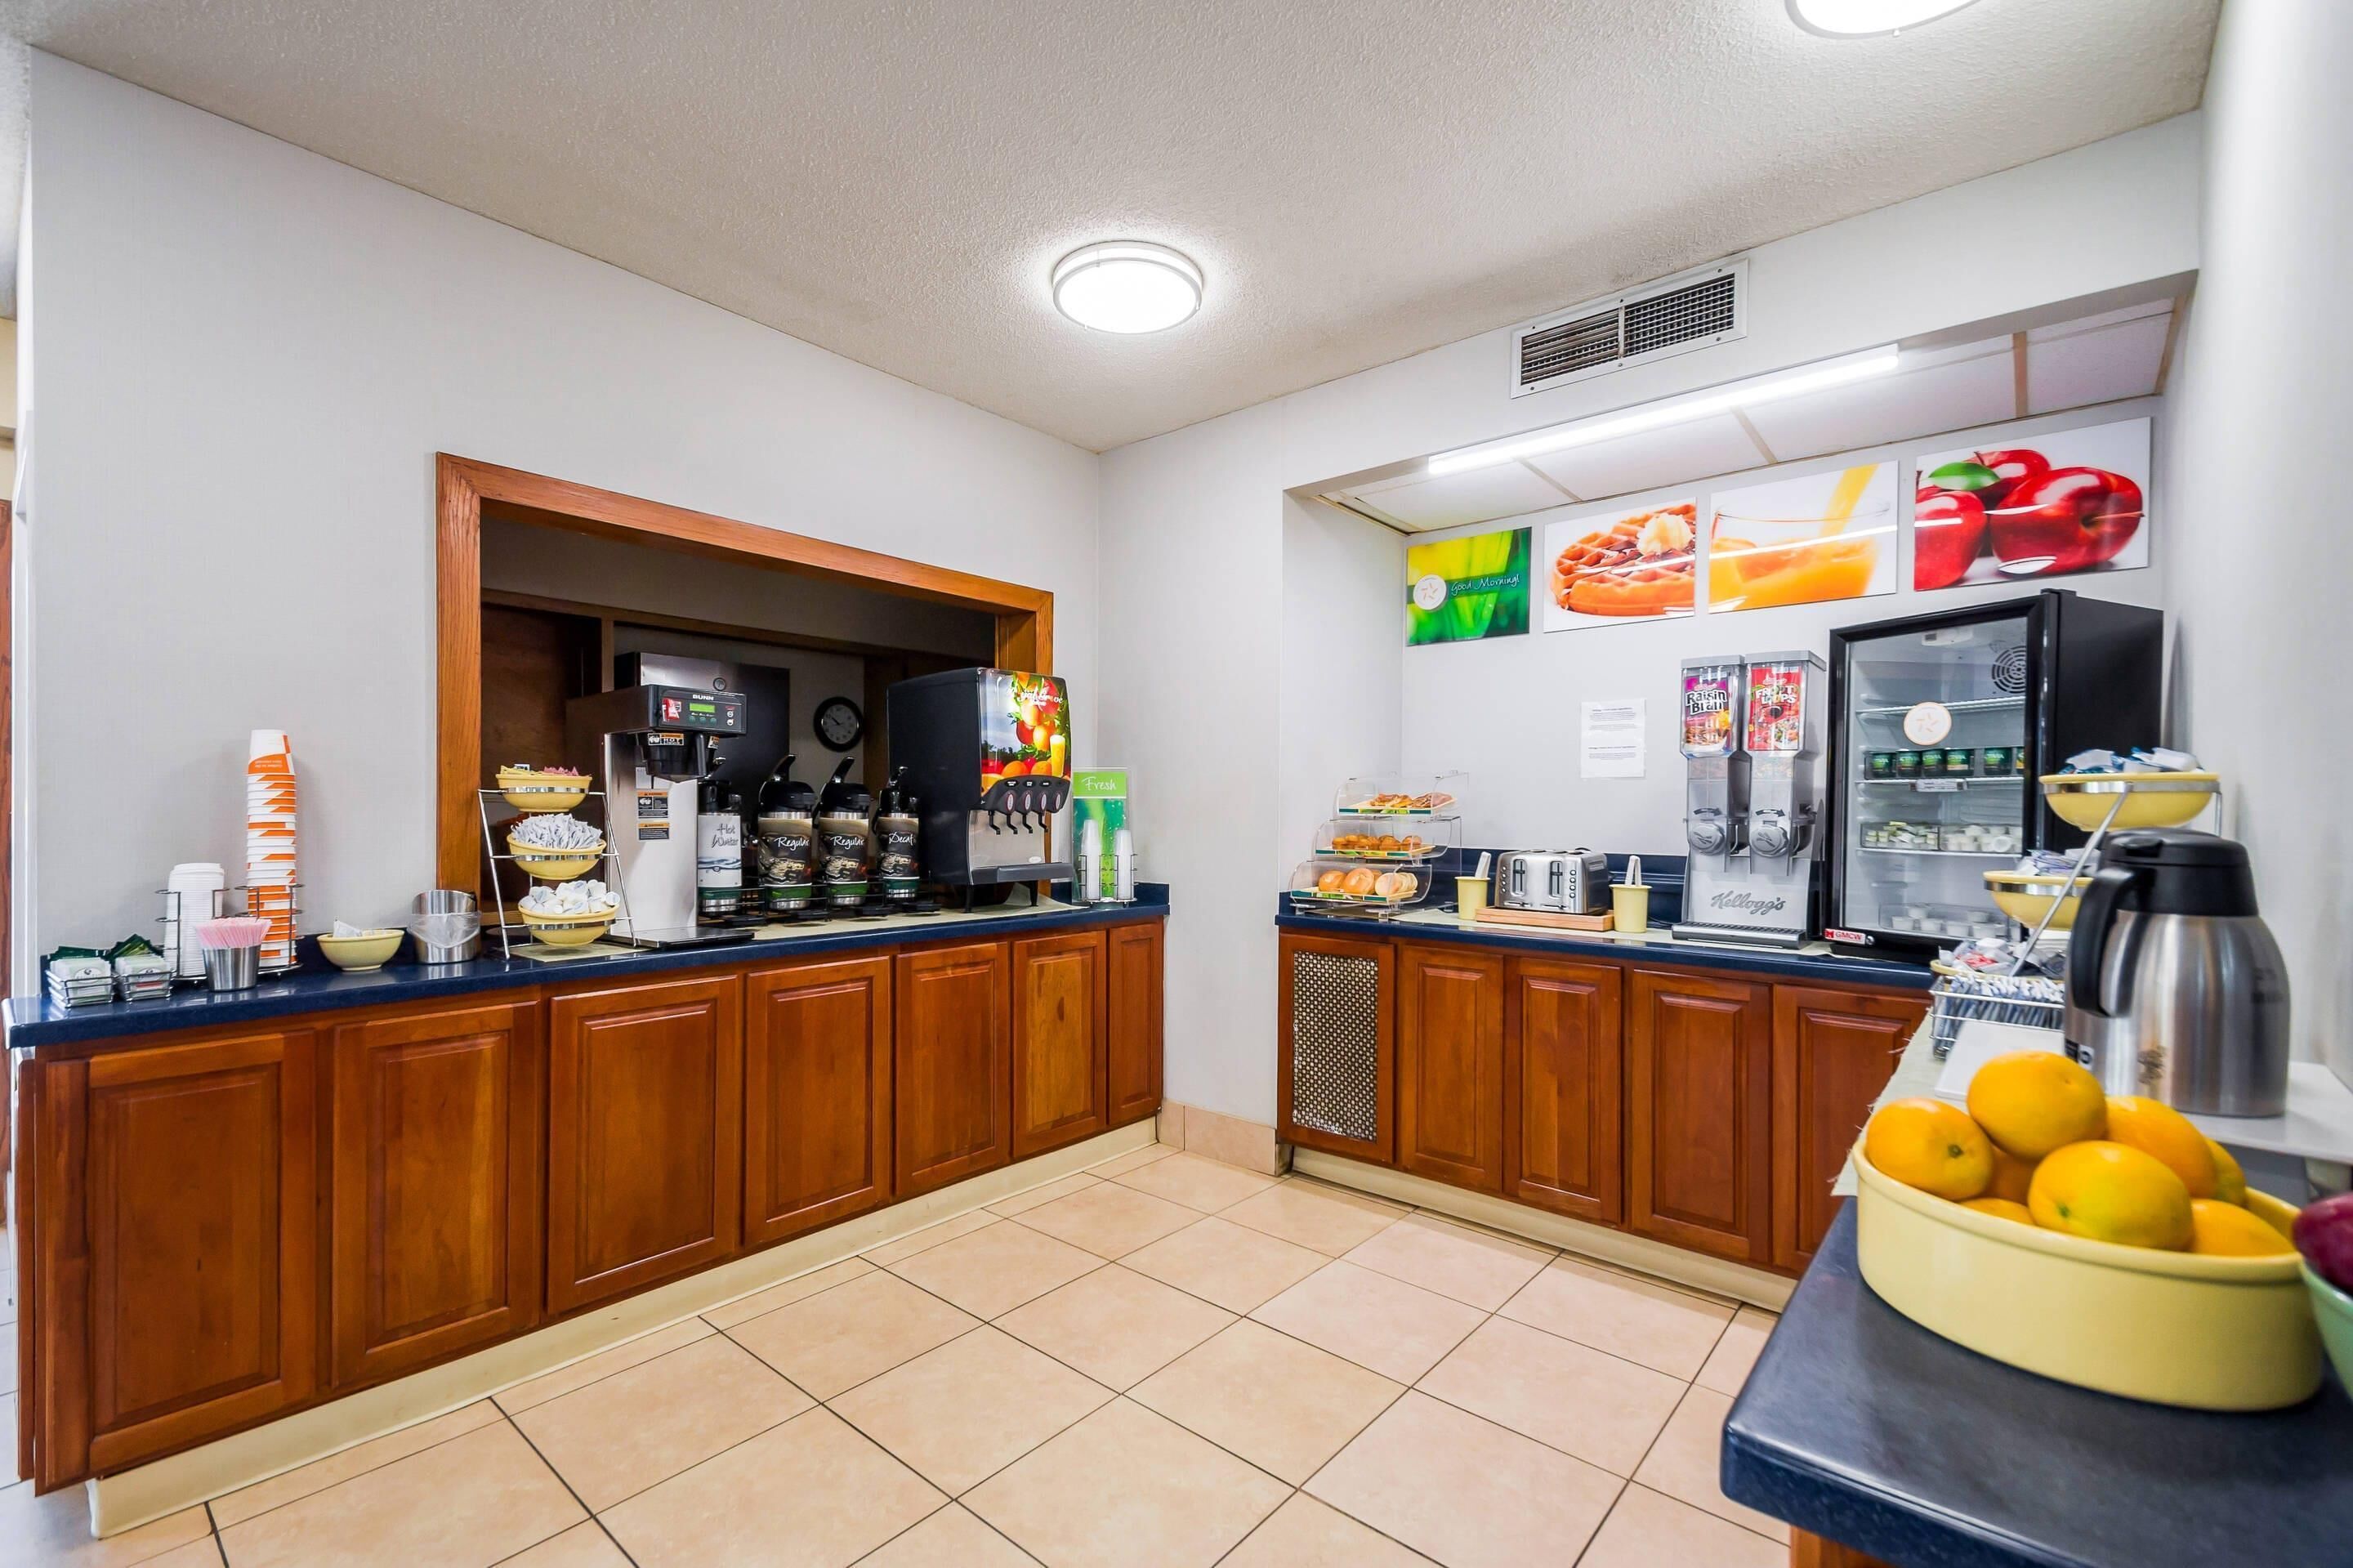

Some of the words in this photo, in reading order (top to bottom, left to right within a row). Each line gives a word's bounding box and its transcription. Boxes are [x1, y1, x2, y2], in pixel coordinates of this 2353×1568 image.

[1451, 581, 1472, 596] Good
[1475, 574, 1520, 589] Morning!
[1685, 690, 1727, 705] Raisin
[1081, 776, 1117, 791] Fresh
[717, 823, 735, 835] Hot
[774, 836, 810, 851] Regular
[830, 835, 864, 850] Regular
[888, 832, 914, 846] Decaf
[1711, 890, 1786, 915] Kellogg's
